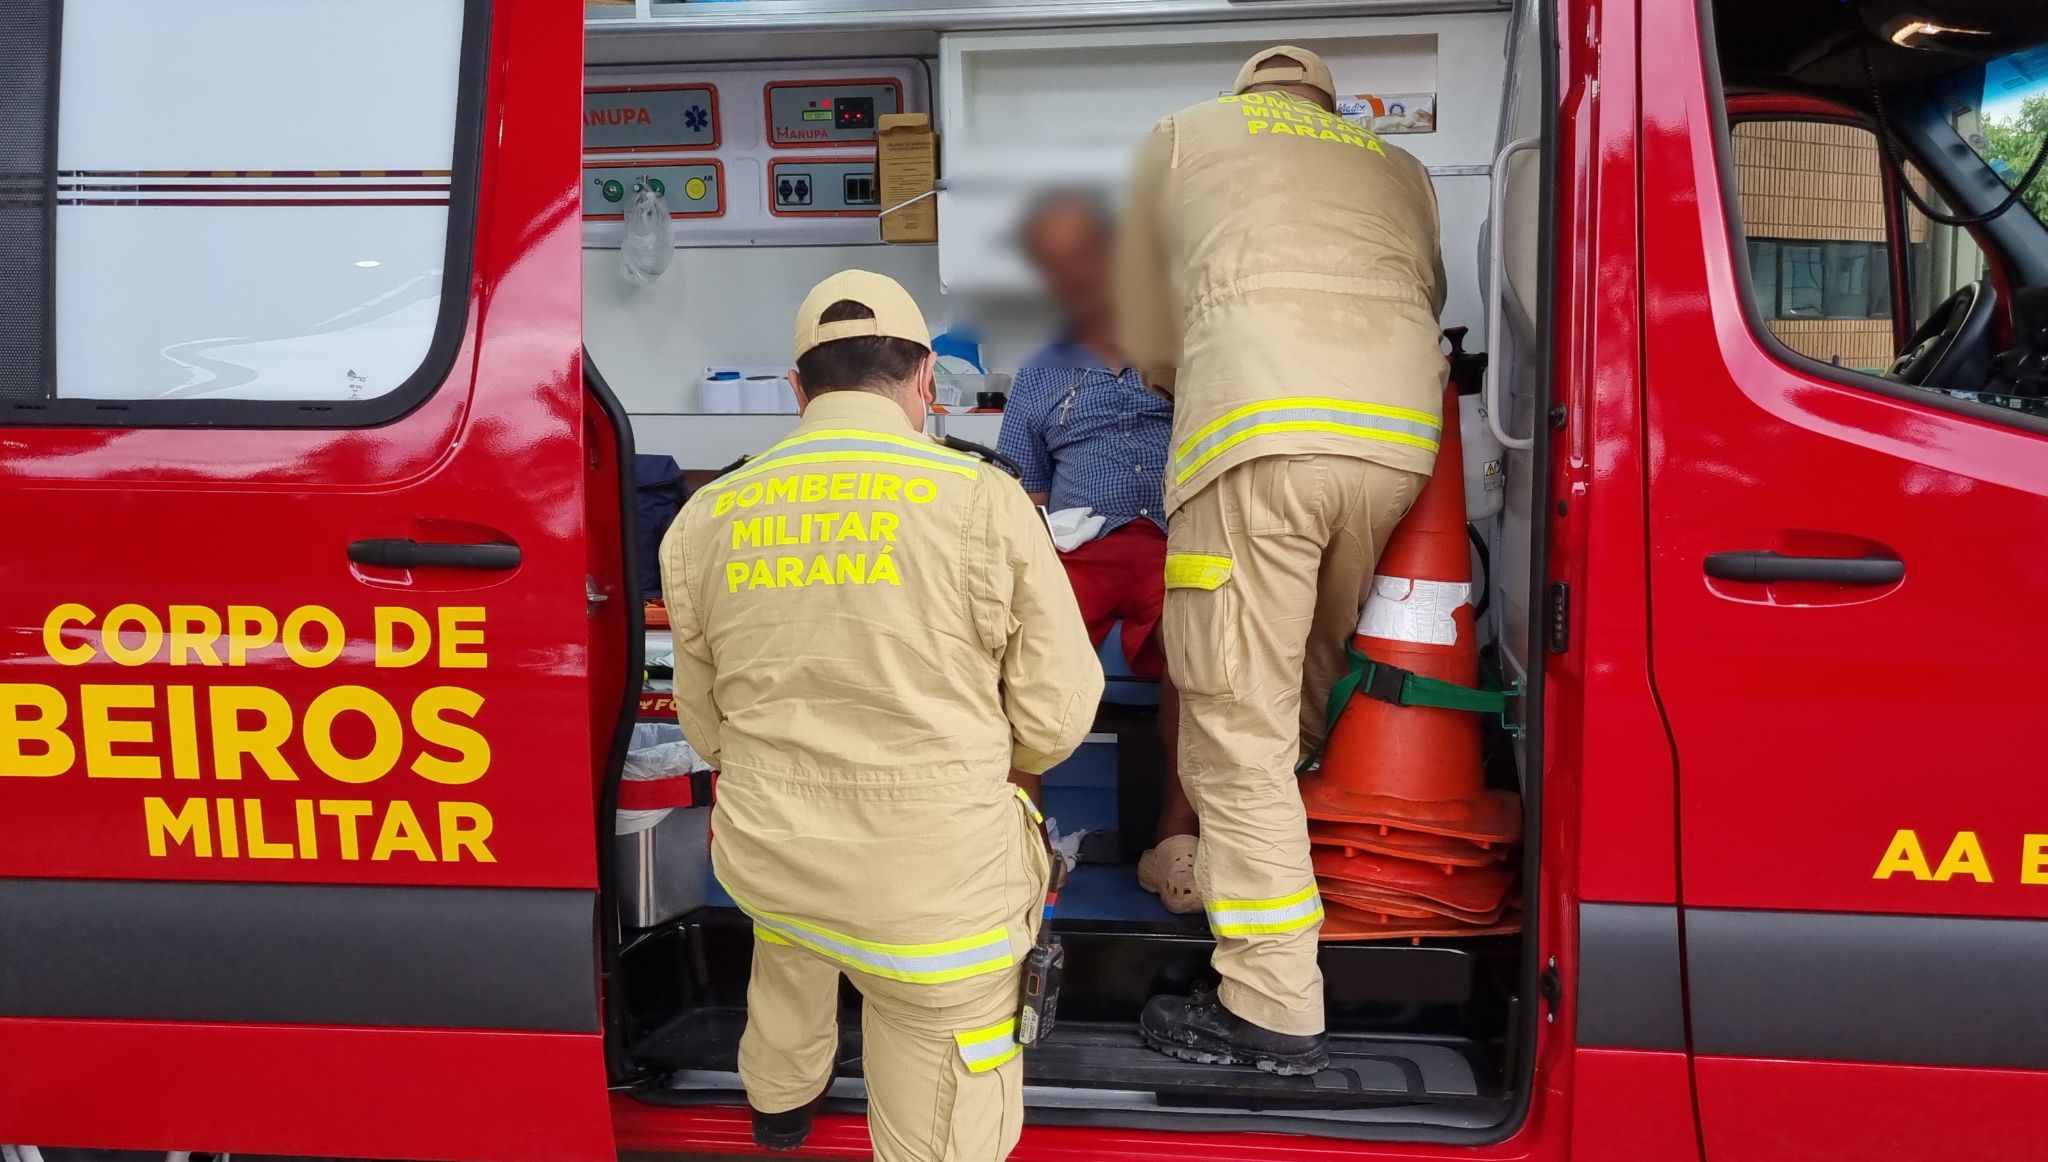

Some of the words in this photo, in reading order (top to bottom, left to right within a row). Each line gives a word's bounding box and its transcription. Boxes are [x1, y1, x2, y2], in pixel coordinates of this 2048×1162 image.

[776, 126, 829, 140] MANUPA
[713, 472, 938, 518] BOMBEIRO
[731, 511, 900, 550] MILITAR
[725, 545, 902, 593] PARANÁ
[42, 603, 347, 668] CORPO
[373, 606, 489, 668] DE
[0, 683, 491, 785] BEIROS
[143, 796, 498, 863] MILITAR
[1872, 829, 1995, 884] AA
